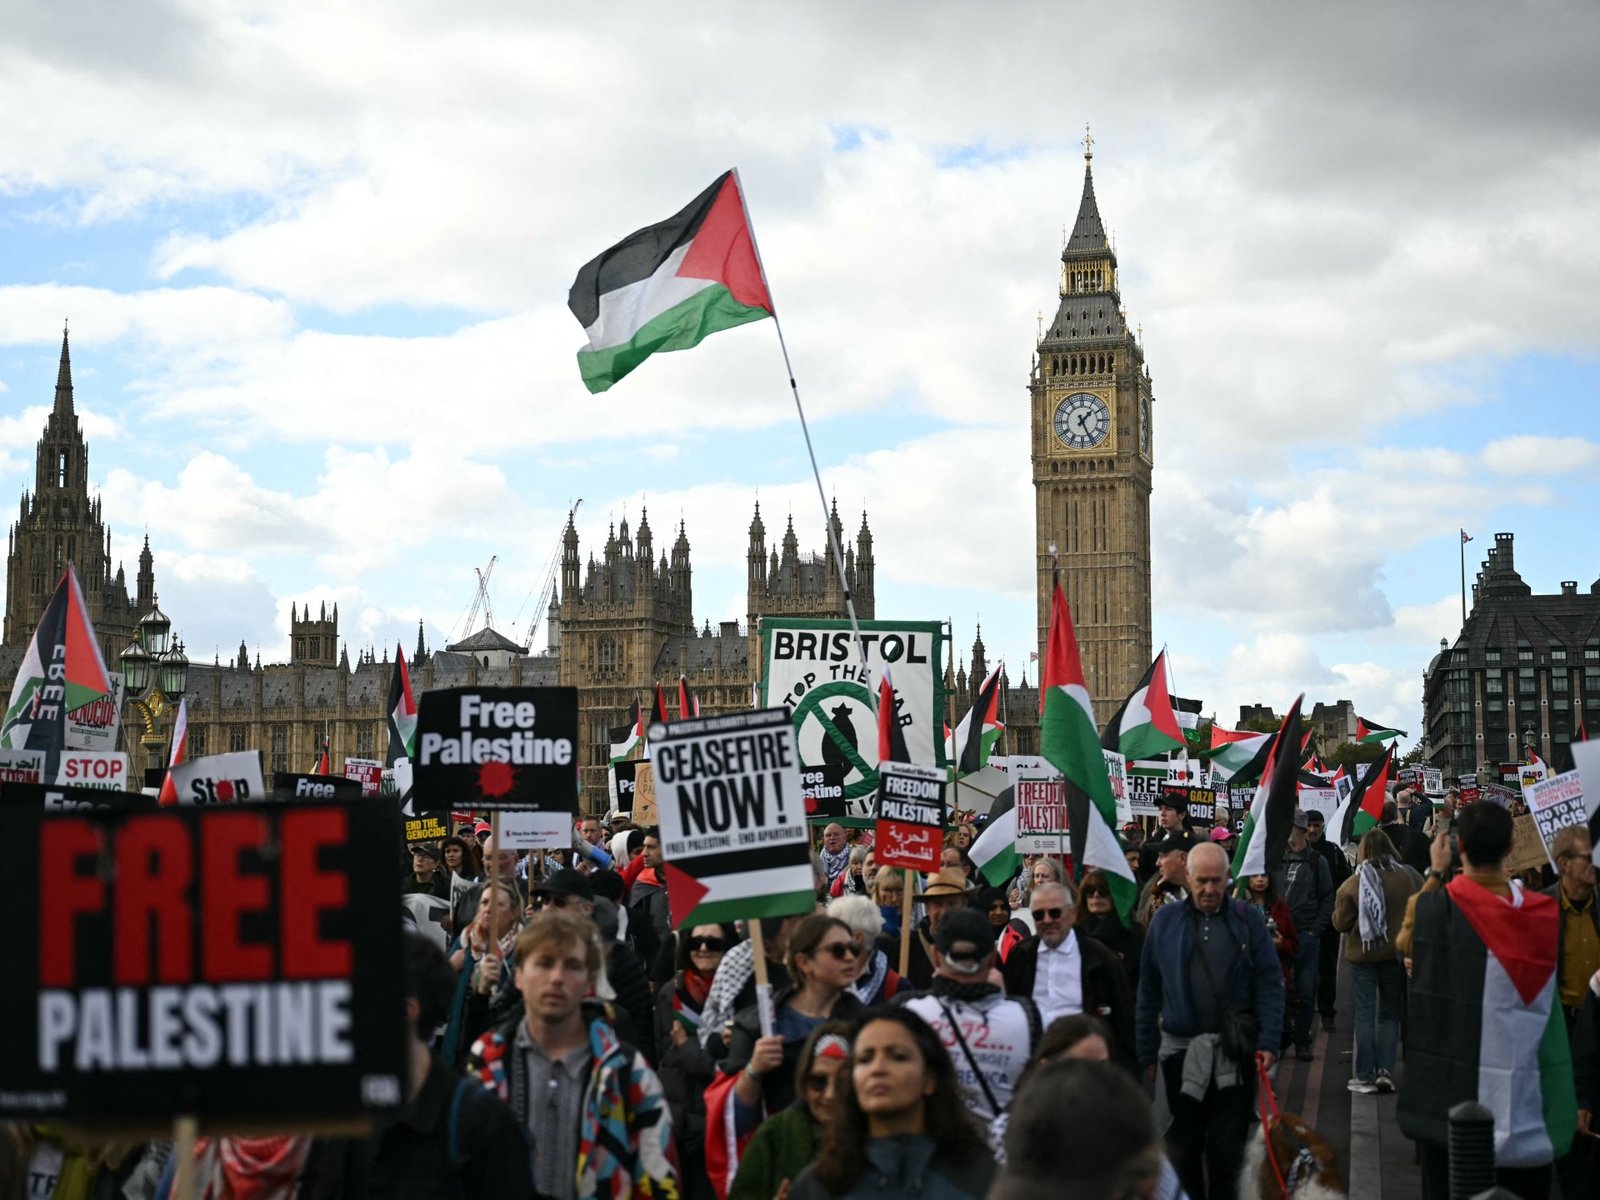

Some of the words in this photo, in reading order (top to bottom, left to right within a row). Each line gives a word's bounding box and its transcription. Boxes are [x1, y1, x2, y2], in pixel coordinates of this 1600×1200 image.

[774, 631, 927, 664] BRISTOL
[782, 672, 816, 708] TOP
[829, 664, 872, 685] THE
[460, 694, 536, 729] Free
[420, 730, 572, 766] Palestine
[658, 730, 792, 785] CEASEFIRE
[65, 759, 122, 779] STOP
[358, 766, 368, 775] NOT
[801, 771, 824, 784] ree
[1504, 774, 1520, 782] ISRAE
[296, 778, 335, 799] Free
[801, 783, 842, 798] estine
[885, 776, 940, 800] FREEDOM
[1190, 790, 1214, 803] GAZA
[1535, 781, 1581, 799] INTERNATIONA
[1560, 787, 1583, 801] STRIK
[677, 772, 788, 837] NOW!
[881, 800, 941, 825] PALESTINE
[1187, 803, 1214, 819] CIDE
[1535, 809, 1553, 821] NO
[1553, 803, 1568, 815] TO
[405, 819, 422, 830] END
[422, 818, 439, 829] THE
[1540, 808, 1588, 835] RACIS
[406, 826, 447, 840] GENOCIDE
[889, 825, 929, 844] الحرية
[882, 840, 934, 861] لفلسطين
[39, 808, 353, 987] FREE
[38, 979, 355, 1072] PALESTINE
